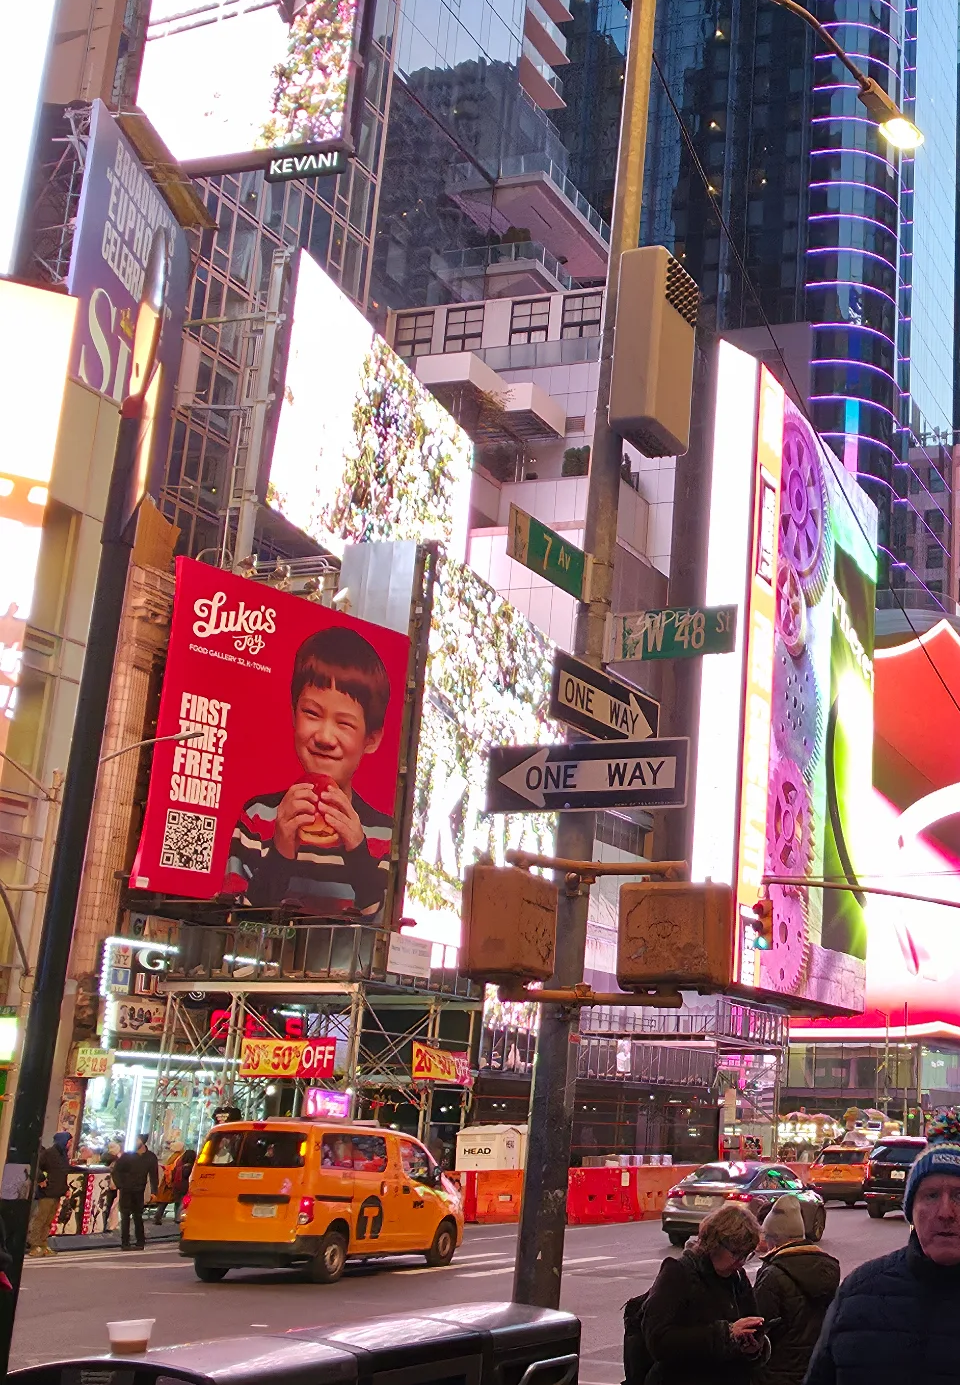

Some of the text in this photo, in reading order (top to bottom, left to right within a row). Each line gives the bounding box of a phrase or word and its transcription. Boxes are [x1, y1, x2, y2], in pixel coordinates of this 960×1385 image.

[269, 152, 339, 176] KEVANI
[542, 534, 553, 571] 7
[193, 591, 277, 638] Luka's
[645, 611, 731, 653] W 48 St
[189, 643, 209, 658] FOOD
[208, 648, 238, 664] GALLERY
[180, 692, 231, 728] FIRST
[565, 677, 639, 735] ONE WAY
[178, 719, 228, 754] TIME?
[172, 747, 224, 782] FREE
[525, 760, 666, 791] ONE WAY
[170, 774, 222, 810] SLIDER!
[302, 1046, 335, 1070] OFF
[463, 1147, 492, 1155] HEAD
[362, 1206, 380, 1239] T
